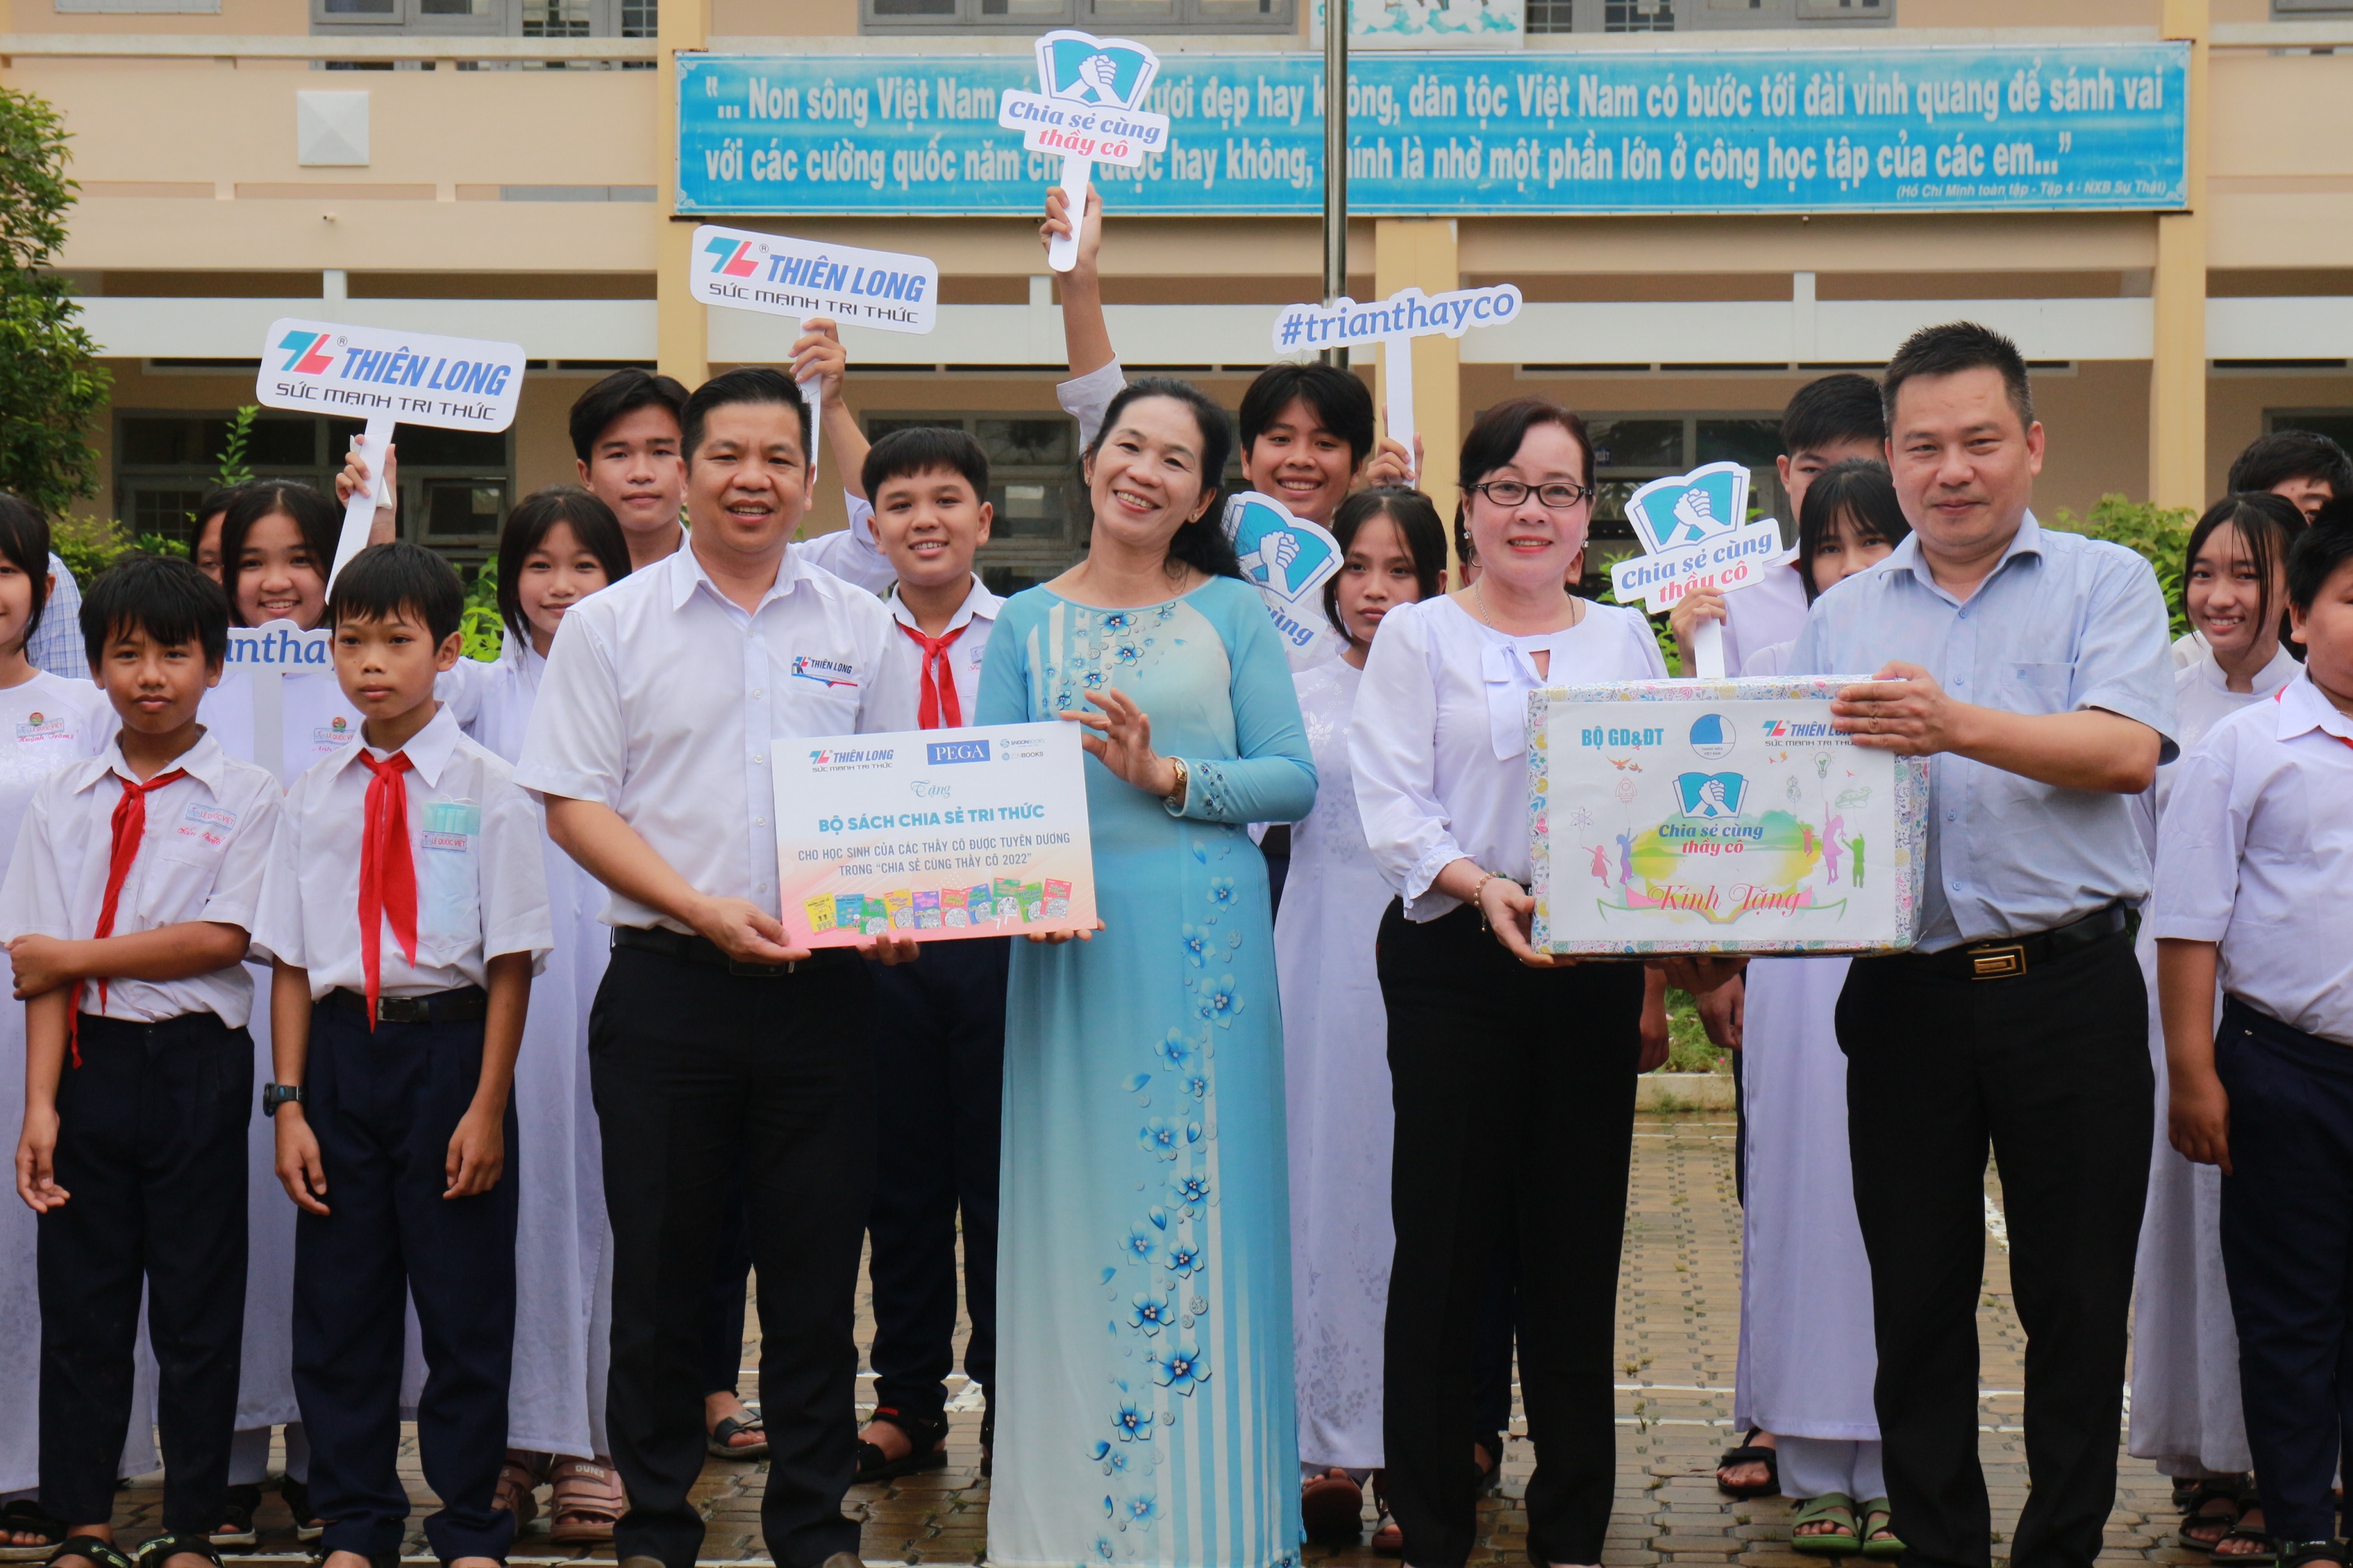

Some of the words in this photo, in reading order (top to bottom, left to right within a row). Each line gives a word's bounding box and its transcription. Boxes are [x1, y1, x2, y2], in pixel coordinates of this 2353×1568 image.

[749, 77, 798, 119] Non
[808, 81, 868, 128] sông
[877, 77, 929, 130] Việt
[938, 78, 995, 119] Nam
[1144, 74, 1194, 119] tươi
[1201, 76, 1249, 130] đẹp
[1258, 75, 1304, 126] hay
[1313, 74, 1401, 126] kông,
[1410, 75, 1456, 116] dân
[1465, 75, 1507, 125] tộc
[1517, 74, 1570, 125] Việt
[1579, 75, 1638, 117] Nam
[1647, 74, 1678, 117] có
[1688, 73, 1751, 116] bước
[1761, 73, 1795, 116] tới
[1805, 72, 1844, 115] đài
[1853, 70, 1908, 114] vinh
[1917, 73, 1998, 122] quang
[2009, 57, 2042, 112] để
[2050, 66, 2114, 111] sánh
[2123, 64, 2163, 109] vai
[1009, 101, 1065, 125] Chia
[1068, 113, 1096, 130] sẻ
[1100, 116, 1161, 145] cùng
[1039, 129, 1095, 156] thầy
[1100, 140, 1128, 158] cô
[706, 139, 742, 180] với
[752, 138, 797, 180] các
[807, 139, 884, 189] cường
[893, 134, 955, 190] quốc
[965, 141, 1019, 181] năm
[1172, 139, 1217, 189] hay
[1227, 138, 1312, 188] không,
[1402, 137, 1424, 179] là
[1434, 137, 1482, 179] nhờ
[1490, 138, 1540, 189] một
[1549, 130, 1612, 188] phần
[1622, 137, 1661, 179] lớn
[1671, 132, 1686, 179] ở
[1696, 138, 1759, 188] công
[1769, 138, 1816, 188] học
[1825, 137, 1868, 188] tập
[1878, 130, 1926, 177] của
[1936, 133, 1984, 176] các
[768, 254, 849, 292] THIÊN
[850, 267, 926, 302] LONG
[709, 282, 749, 299] SỨC
[825, 300, 857, 315] TRI
[863, 306, 918, 324] THỨC
[1281, 293, 1514, 345] #trianthayco
[340, 345, 430, 388] THIÊN
[427, 358, 511, 396] LONG
[275, 381, 319, 399] SỨC
[398, 397, 432, 414] TRI
[438, 401, 496, 420] THỨC
[1621, 562, 1676, 589] Chia
[1682, 548, 1707, 573] sẻ
[1713, 532, 1772, 563] cùng
[1721, 560, 1748, 585] cô
[1265, 605, 1314, 646] ùng
[811, 659, 833, 670] THIÊN
[833, 662, 852, 674] LONG
[1582, 726, 1603, 750] BỘ
[1608, 728, 1664, 746] GD&ĐT
[1791, 721, 1827, 737] THIÊN
[833, 749, 864, 763] THIÊN
[866, 749, 894, 762] LONG
[935, 745, 985, 761] PEGA
[910, 779, 951, 799] Tặng
[819, 815, 844, 835] BỘ
[848, 813, 895, 831] SÁCH
[899, 812, 942, 827] CHIA
[944, 806, 964, 824] SẺ
[968, 808, 994, 822] TRI
[998, 802, 1045, 820] THỨC
[1659, 824, 1696, 838] Chia
[1700, 824, 1718, 838] sẻ
[1722, 823, 1763, 839] cùng
[438, 837, 453, 846] QUỐC
[798, 849, 819, 861] CHO
[823, 848, 842, 861] HỌC
[847, 846, 870, 858] SINH
[874, 842, 895, 856] CỦA
[899, 842, 918, 855] CÁC
[922, 838, 947, 853] THẦY
[952, 838, 965, 851] CÔ
[969, 836, 996, 851] ĐƯỢC
[1000, 834, 1032, 848] TUYÊN
[1036, 832, 1070, 846] DƯƠNG
[1682, 838, 1721, 856] thầy
[1725, 839, 1744, 853] cô
[839, 864, 872, 876] TRONG
[908, 857, 921, 872] SẺ
[925, 857, 952, 870] CÙNG
[955, 853, 981, 868] THẦY
[985, 853, 998, 866] CÔ
[1647, 885, 1721, 911] Kính
[1728, 883, 1801, 917] Tặng
